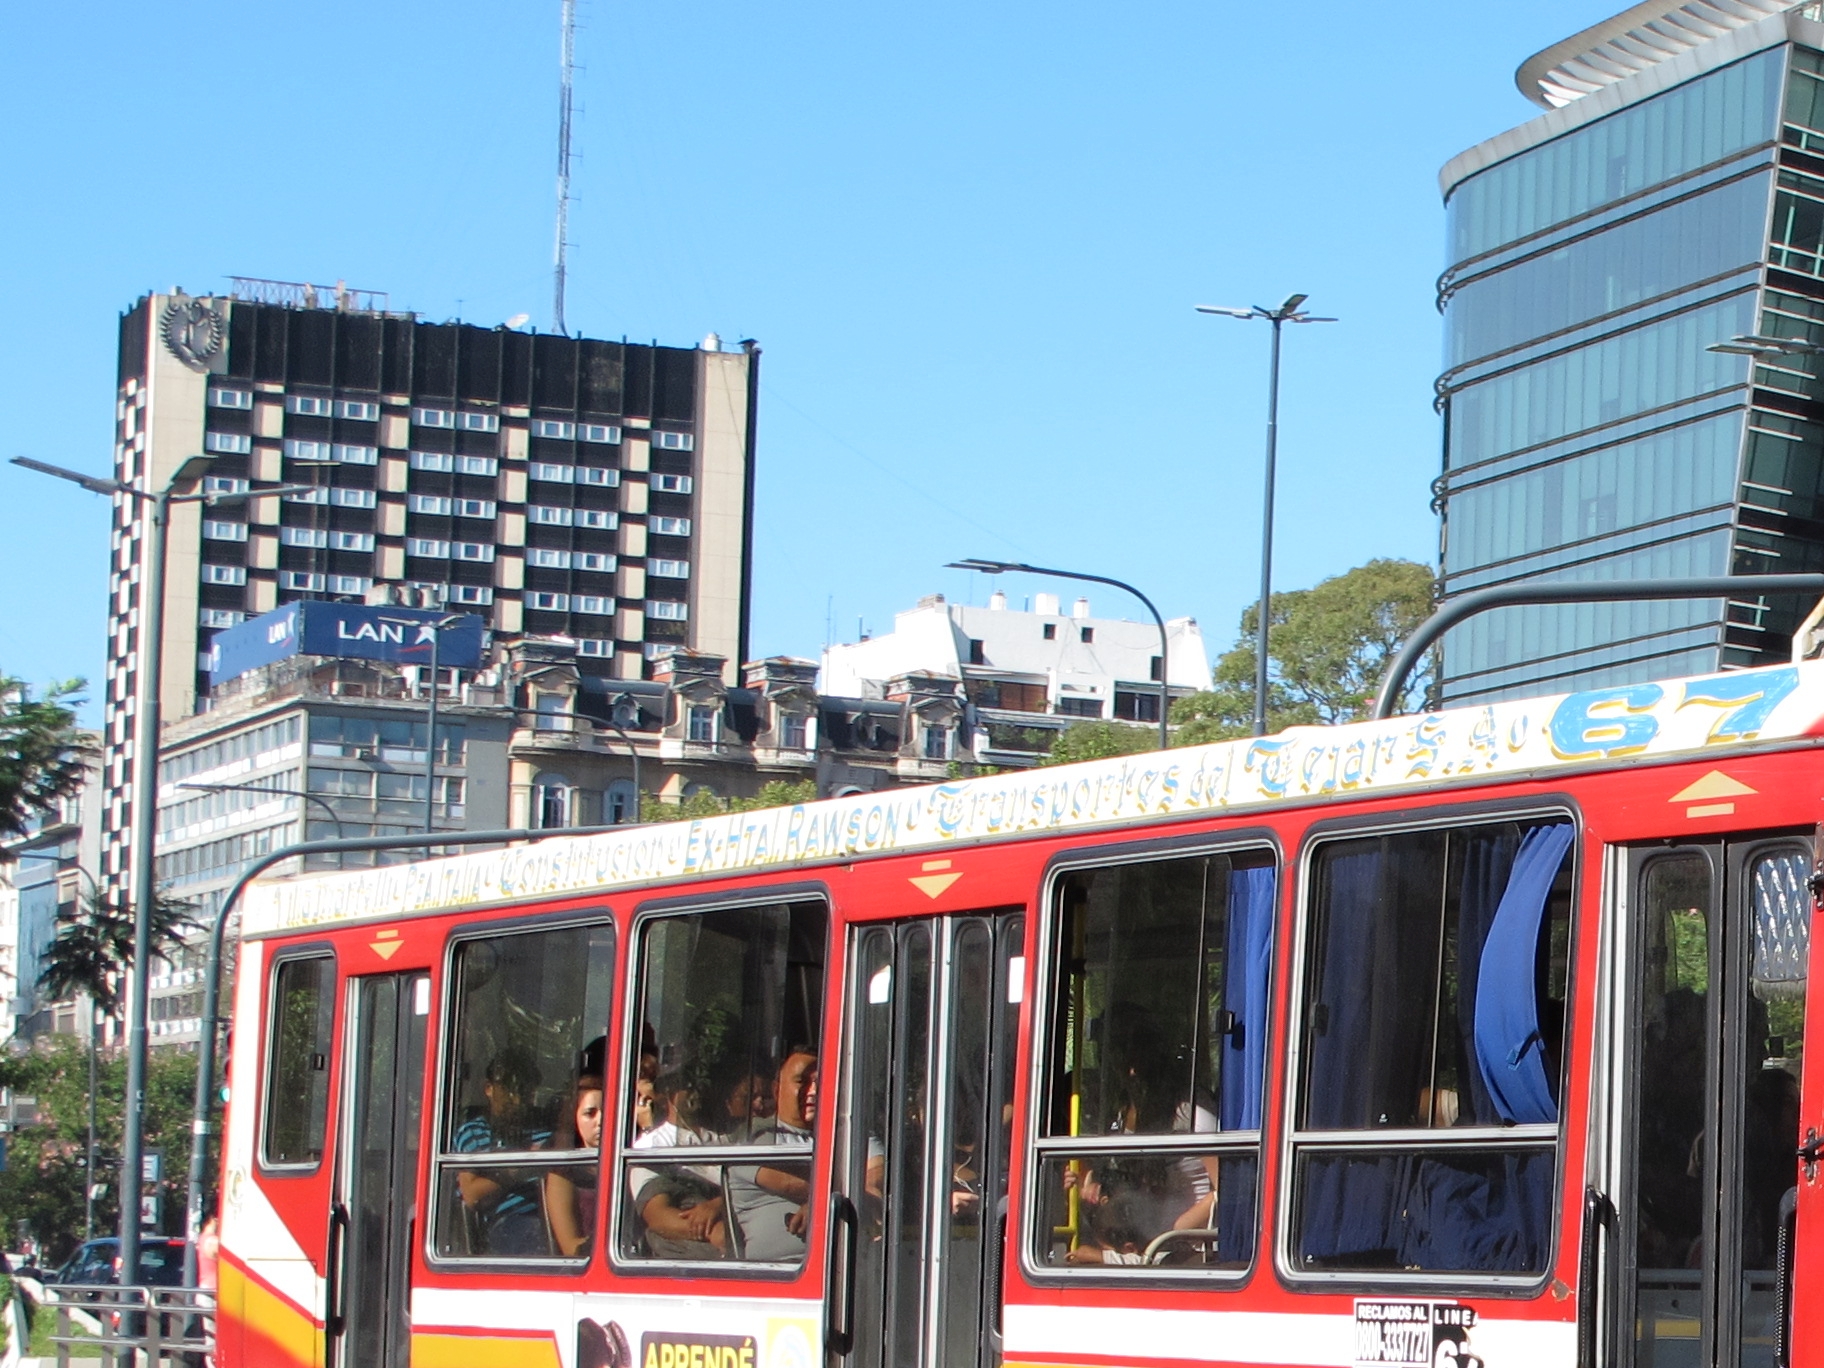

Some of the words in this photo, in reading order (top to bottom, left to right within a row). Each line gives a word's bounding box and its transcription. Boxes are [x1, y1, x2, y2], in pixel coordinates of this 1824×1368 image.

[338, 620, 403, 643] LAN
[1543, 667, 1800, 760] 67
[1357, 1304, 1412, 1321] RECLAMOS
[1412, 1305, 1428, 1321] AL
